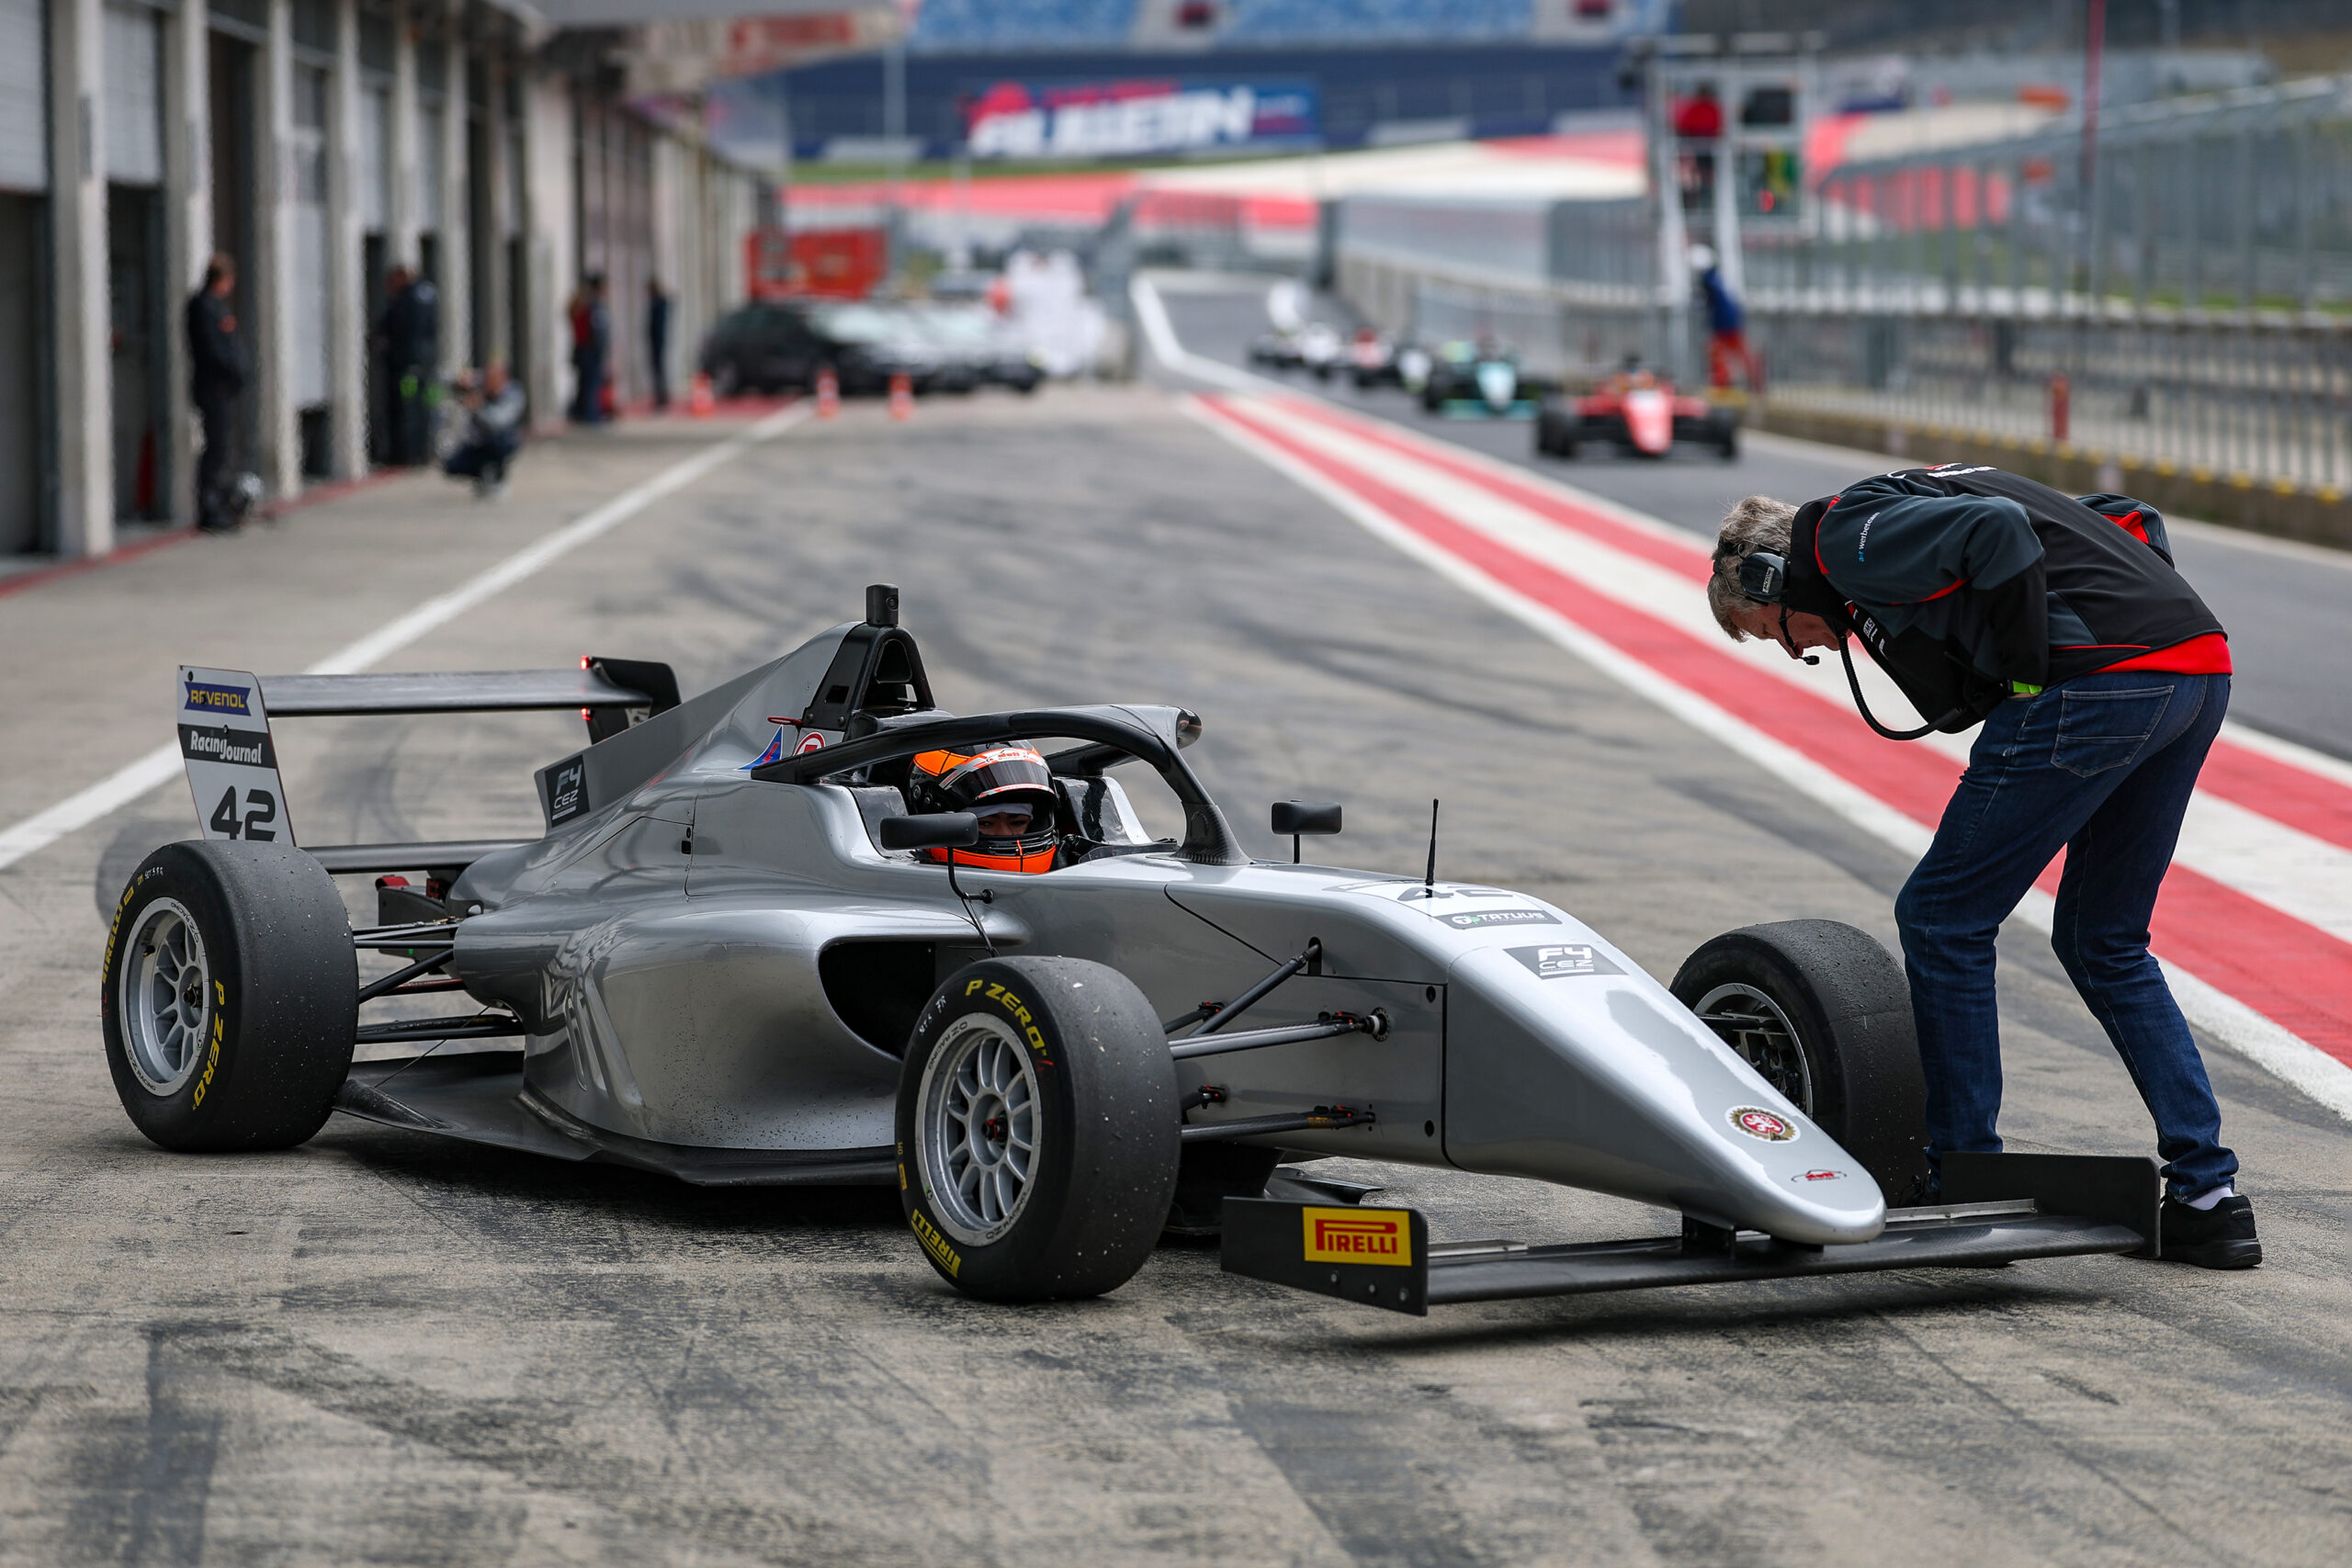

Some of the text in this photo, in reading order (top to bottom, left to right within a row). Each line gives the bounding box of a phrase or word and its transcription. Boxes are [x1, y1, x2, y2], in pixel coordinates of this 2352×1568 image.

[556, 763, 582, 795] F4
[209, 784, 276, 842] 42
[554, 788, 579, 809] CEZ
[1476, 912, 1546, 920] TATUUS
[1538, 946, 1593, 962] F4
[1539, 959, 1594, 970] CEZ
[965, 979, 1046, 1050] P ZERO
[194, 979, 225, 1107] P ZERO
[910, 1208, 962, 1279] PIRELLI
[1315, 1218, 1398, 1255] PIRELLI
